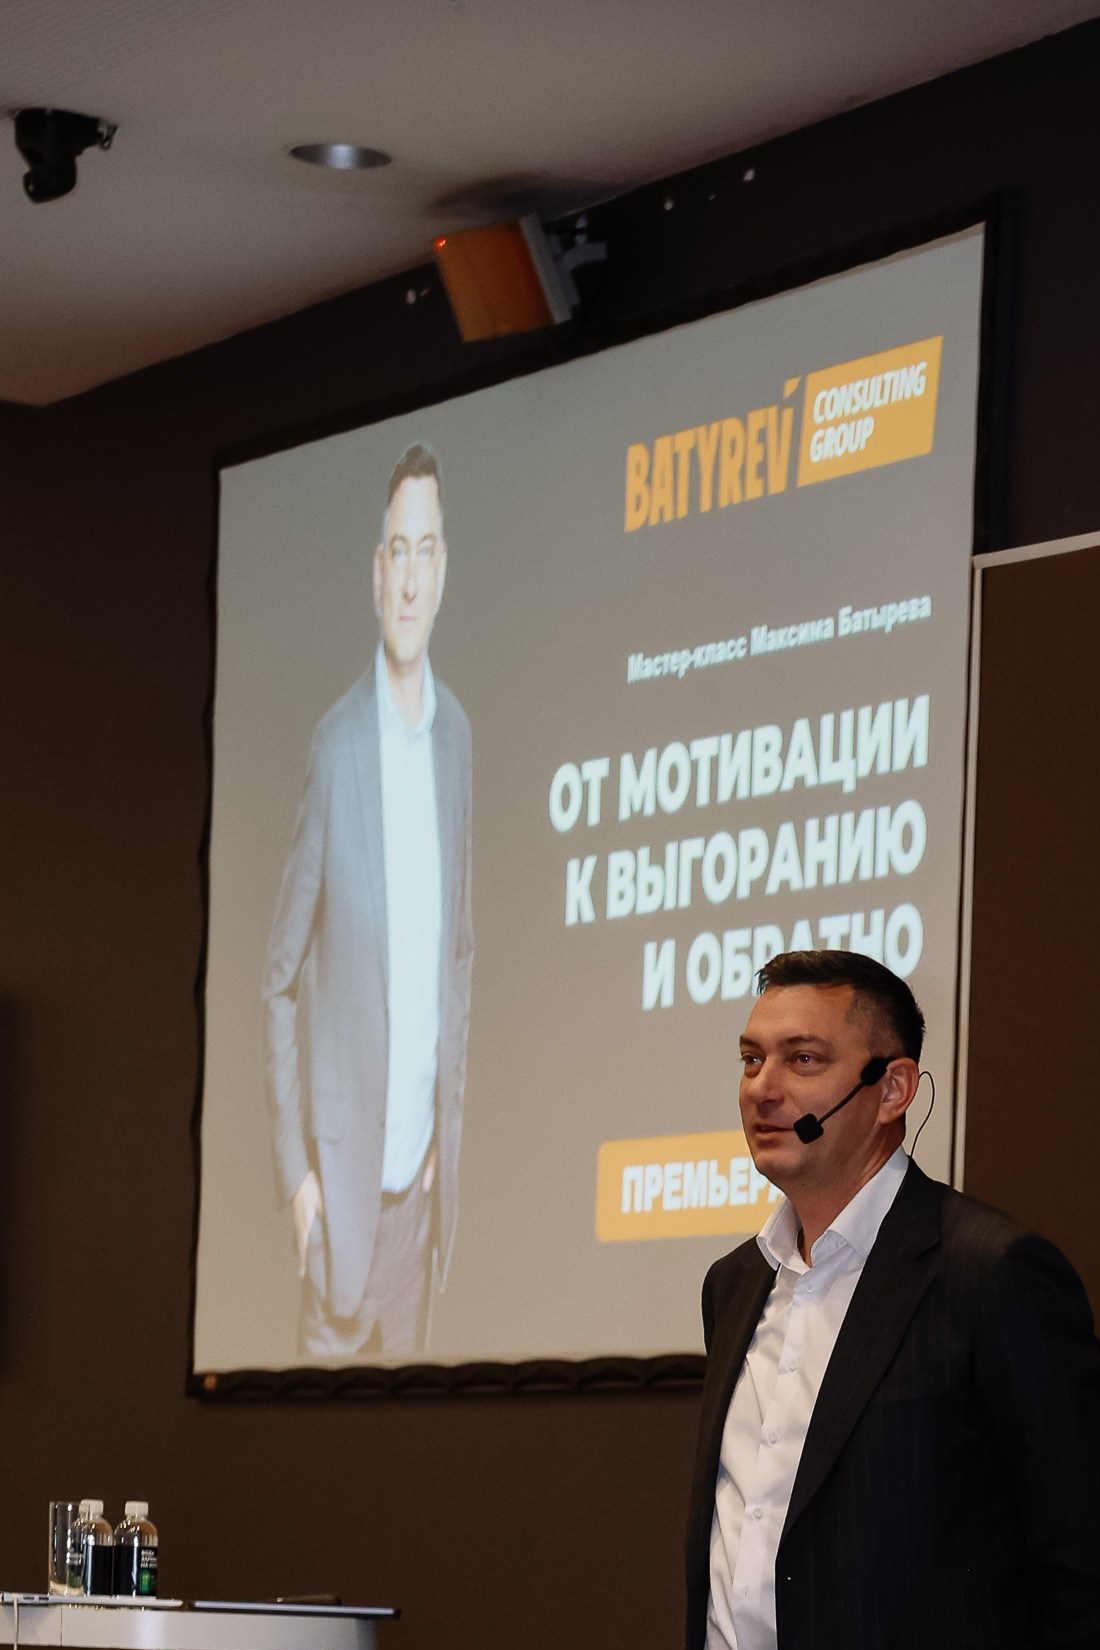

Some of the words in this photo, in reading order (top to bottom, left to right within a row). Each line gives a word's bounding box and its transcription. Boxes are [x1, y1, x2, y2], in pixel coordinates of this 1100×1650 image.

[813, 361, 928, 424] CONSULTING
[624, 376, 800, 533] BATYREV
[810, 417, 875, 463] GROUP
[626, 636, 747, 683] Мастер-класс
[750, 615, 834, 656] Максима
[838, 595, 932, 638] Батырева
[549, 757, 610, 832] ОТ
[618, 694, 930, 822] МОТИВАЦИИ
[565, 853, 597, 927] К
[606, 799, 927, 920] ВЫГОРАНИЮ
[642, 938, 676, 1010] И
[621, 1157, 786, 1214] ПРЕМЬЕР
